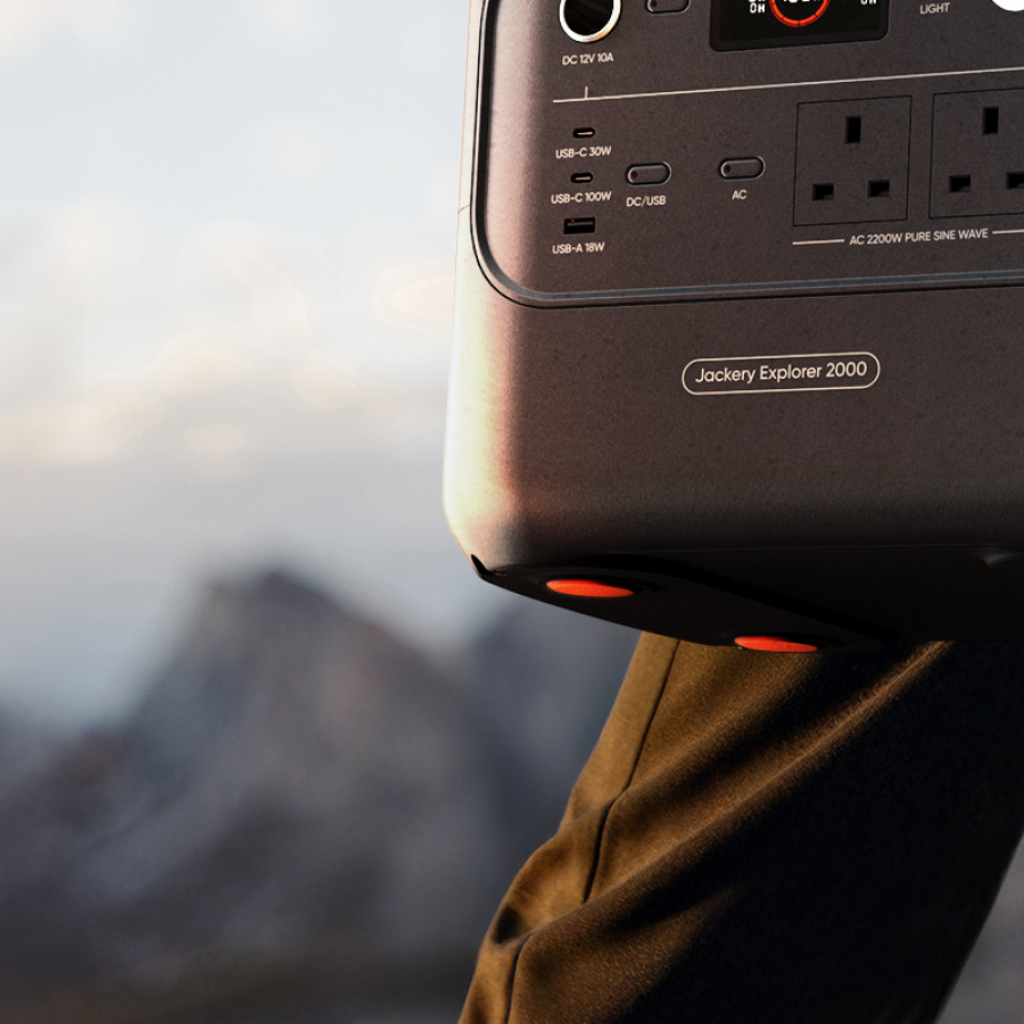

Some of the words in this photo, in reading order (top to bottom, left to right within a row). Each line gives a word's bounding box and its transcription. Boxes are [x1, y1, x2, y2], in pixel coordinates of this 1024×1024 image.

[920, 2, 950, 14] LIGHT
[562, 55, 578, 66] DC
[580, 54, 596, 64] 12V
[598, 52, 614, 63] 10A
[555, 147, 587, 159] USB-C
[589, 146, 612, 157] 30W
[551, 194, 583, 204] USB-C
[585, 191, 612, 202] 100W
[626, 195, 666, 207] DC/USB
[732, 189, 747, 200] AC
[849, 234, 865, 246] AC
[867, 232, 903, 245] 2200W
[905, 231, 931, 242] PURE
[933, 230, 956, 241] SINE
[958, 228, 989, 239] WAVE
[552, 244, 583, 254] USB-A
[585, 242, 605, 253] 18W
[695, 367, 756, 384] Jackery
[759, 364, 822, 383] Explorer
[826, 361, 867, 378] 2000
